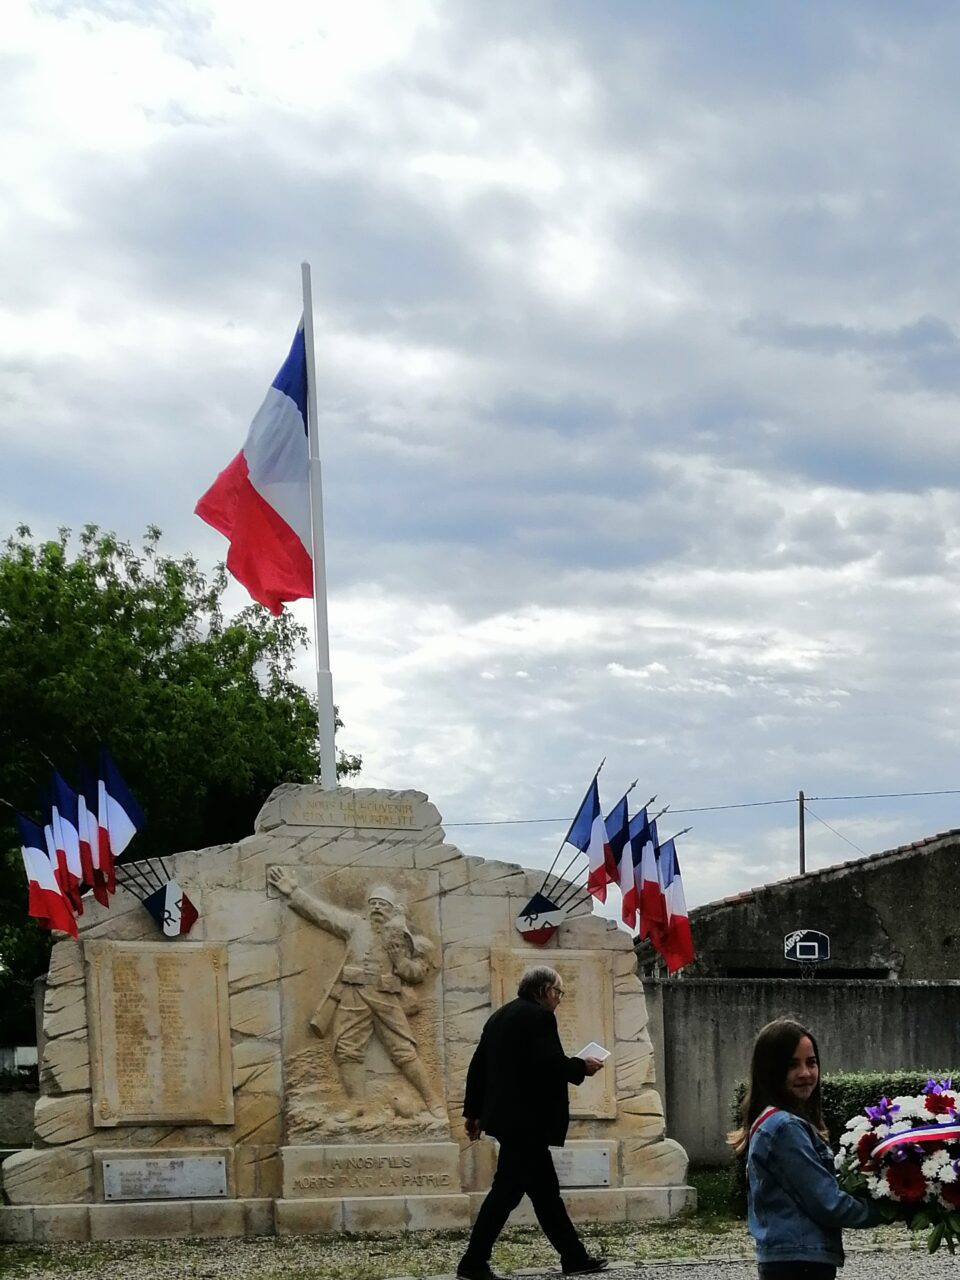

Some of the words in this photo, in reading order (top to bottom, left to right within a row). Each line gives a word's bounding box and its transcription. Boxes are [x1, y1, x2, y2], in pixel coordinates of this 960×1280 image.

[332, 1156, 342, 1169] A
[345, 1155, 375, 1169] NOS
[378, 1154, 412, 1168] FILS
[292, 1175, 336, 1191] MORTS
[401, 1172, 451, 1188] PATRIE
